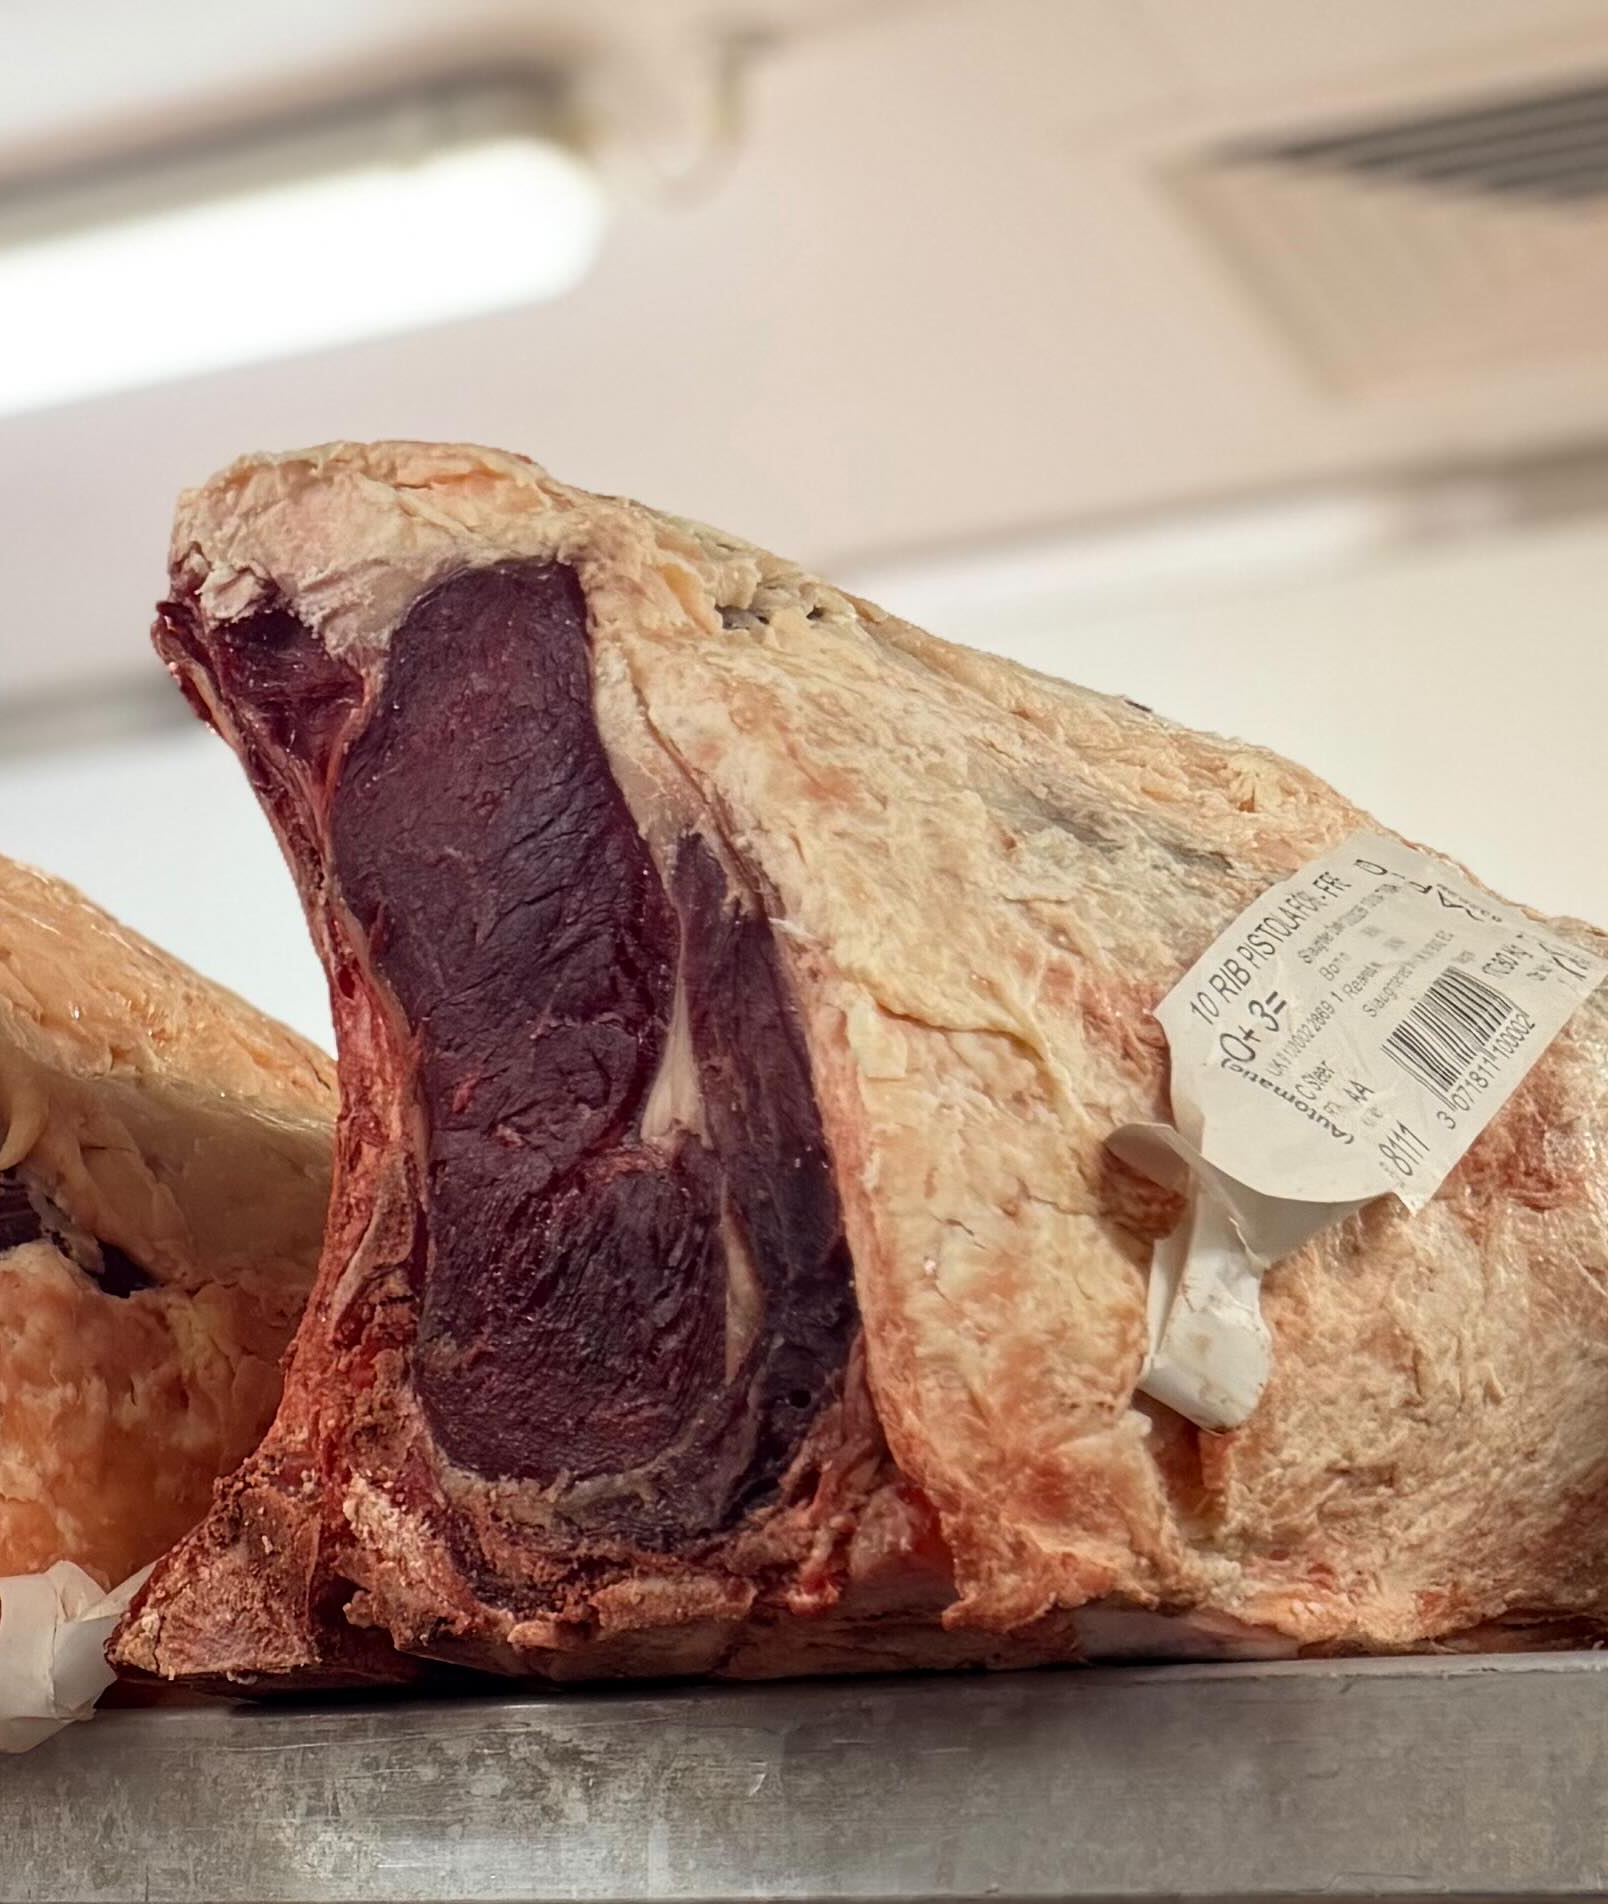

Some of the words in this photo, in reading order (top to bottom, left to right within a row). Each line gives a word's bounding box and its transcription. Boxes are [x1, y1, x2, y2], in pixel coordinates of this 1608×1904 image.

[1190, 992, 1219, 1025] 10
[1209, 959, 1251, 1003] RIB
[1237, 907, 1306, 968] PISTOLA
[1221, 1056, 1355, 1145] (Automatic)
[1437, 1111, 1456, 1129] 3
[1379, 1120, 1430, 1176] 8111
